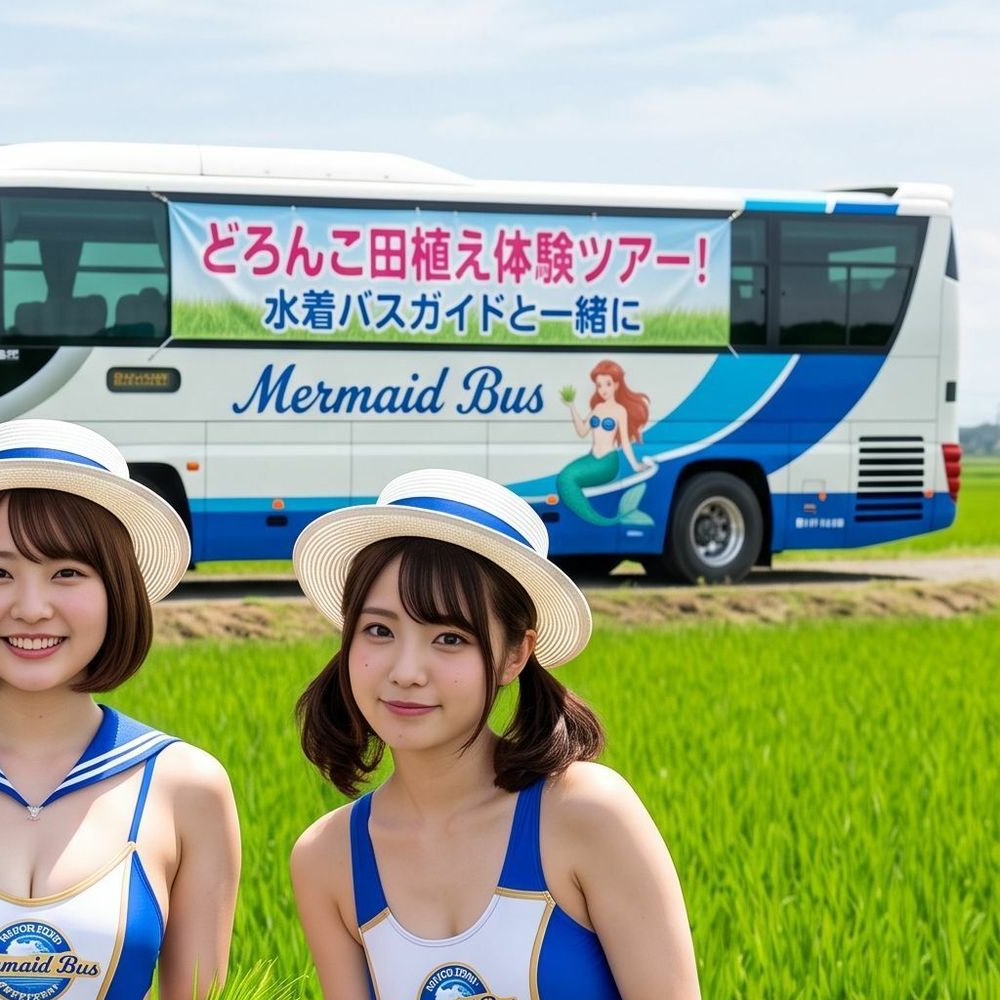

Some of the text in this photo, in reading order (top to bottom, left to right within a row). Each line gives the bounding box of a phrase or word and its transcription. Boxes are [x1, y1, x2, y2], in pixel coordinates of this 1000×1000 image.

[264, 289, 640, 334] 水着バスガイドと一緒に
[232, 364, 545, 415] Mermaid Bus
[56, 955, 99, 976] Bus
